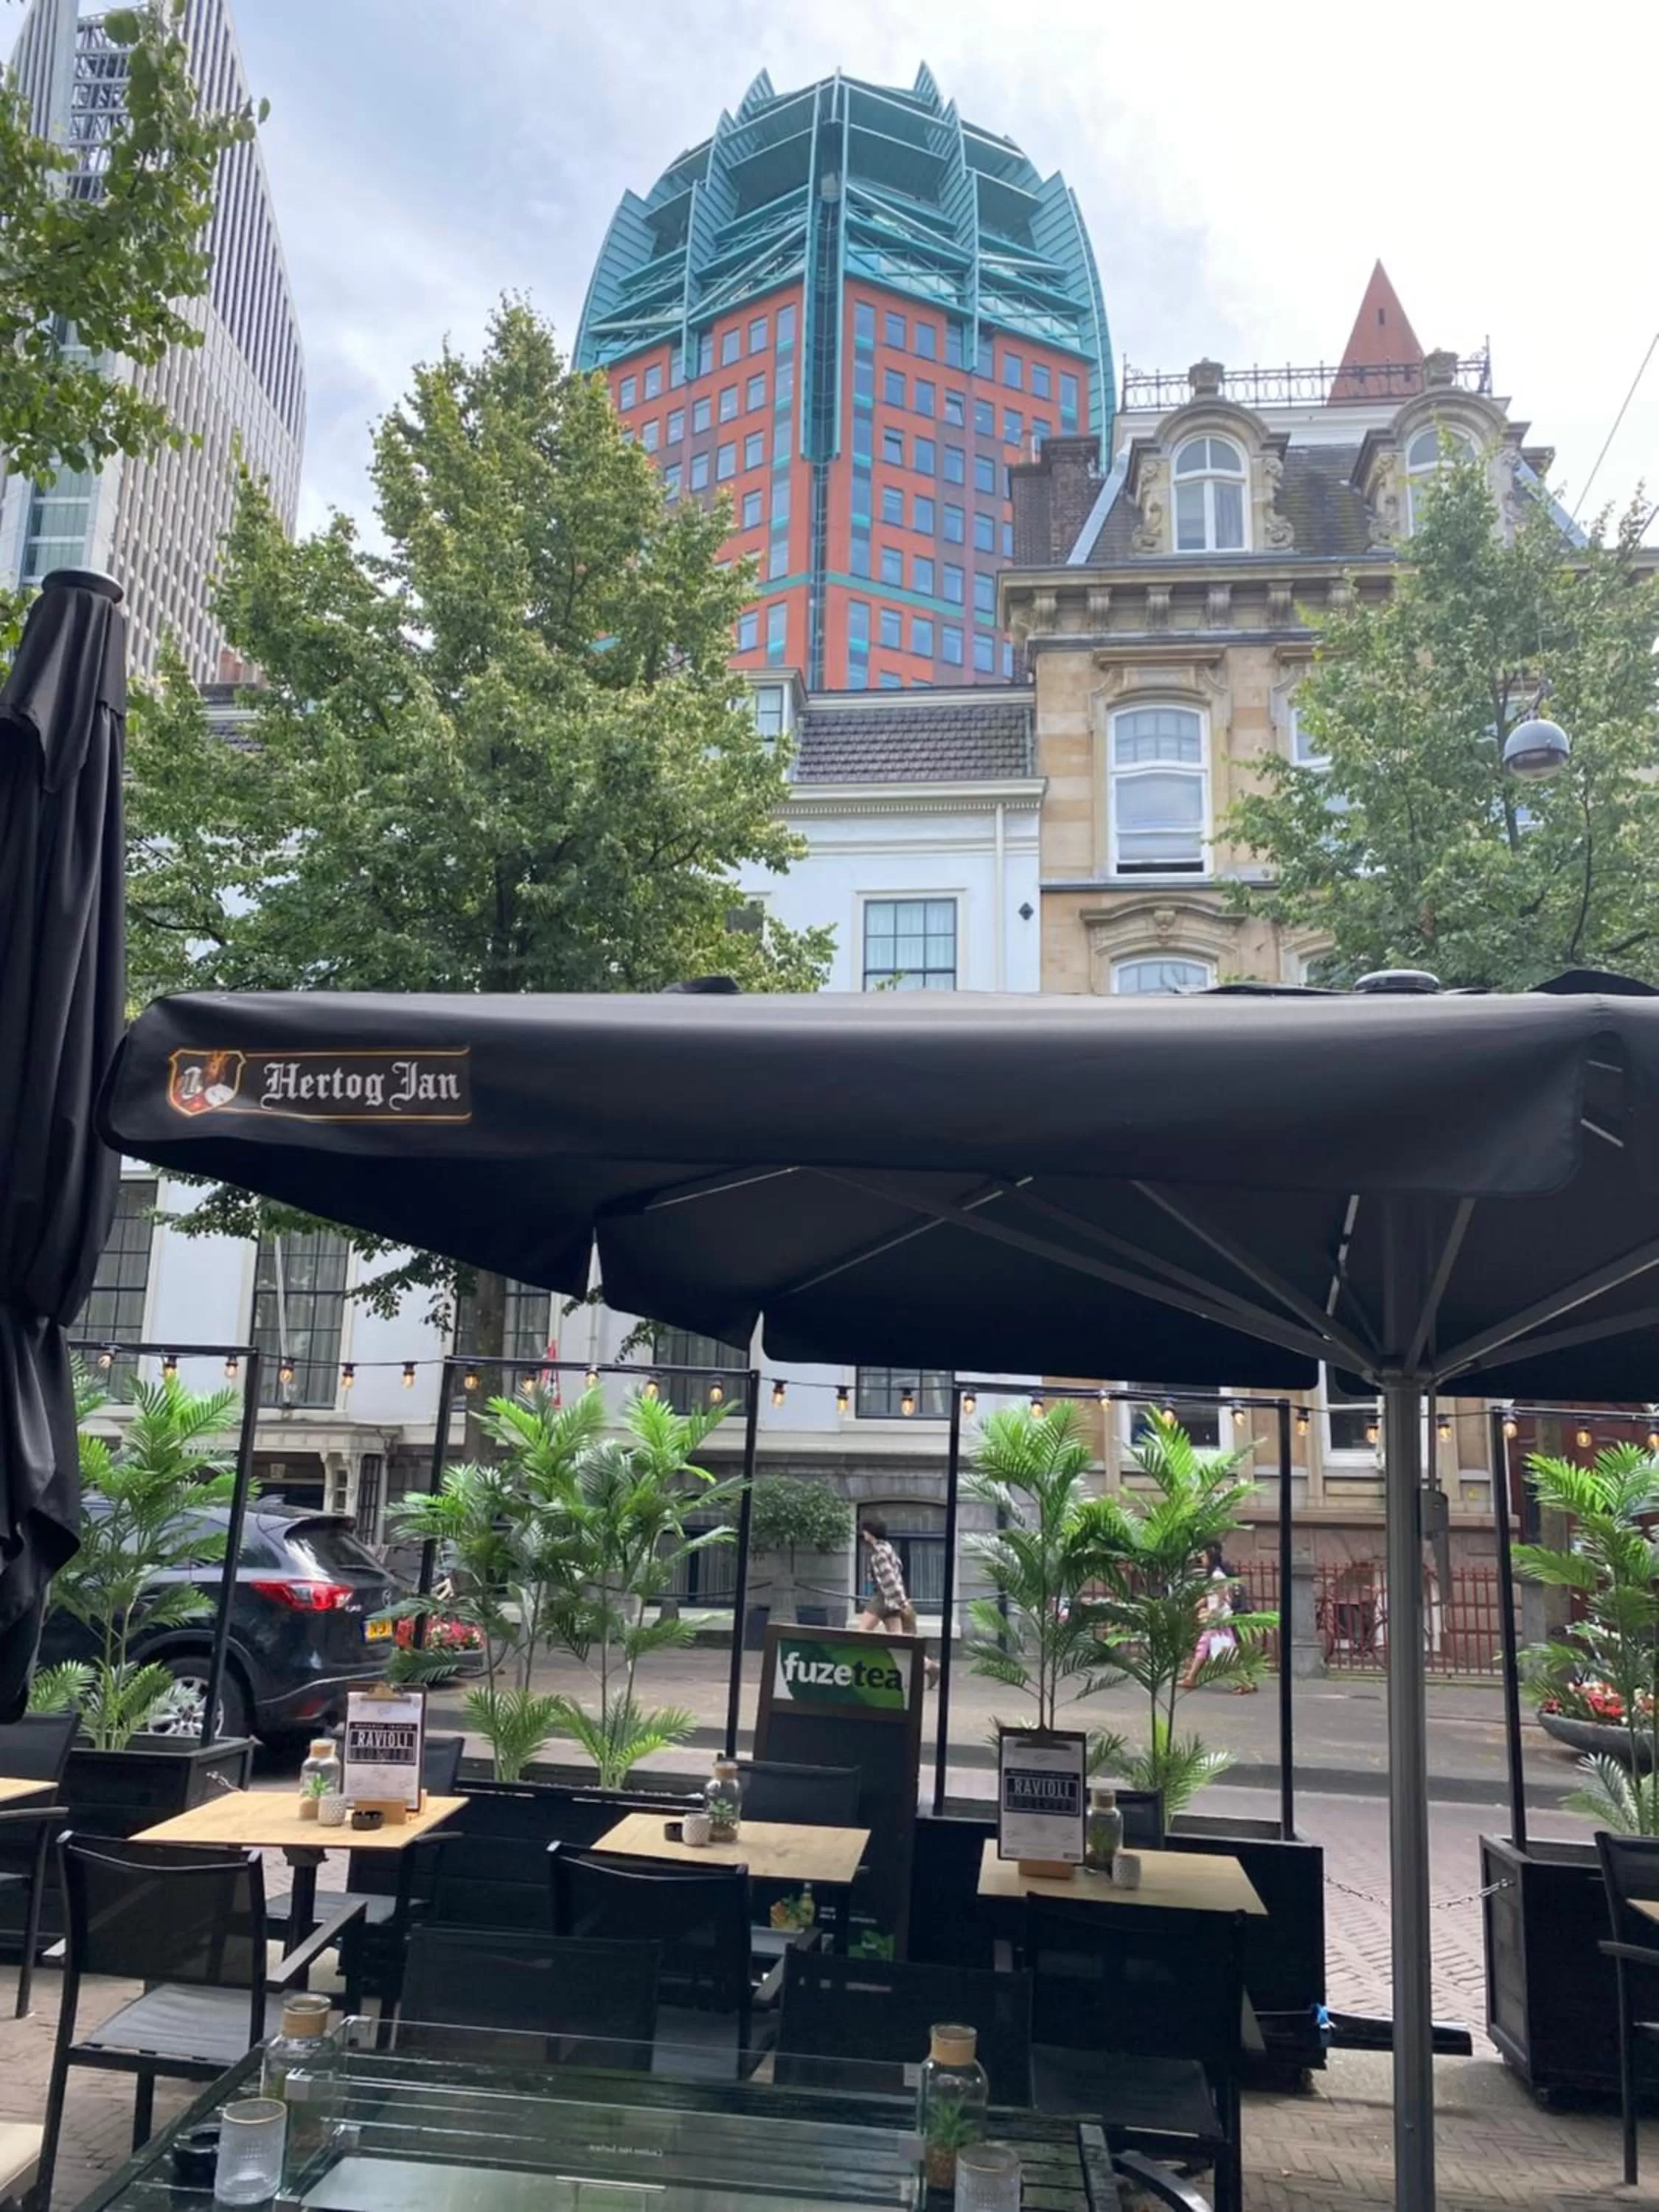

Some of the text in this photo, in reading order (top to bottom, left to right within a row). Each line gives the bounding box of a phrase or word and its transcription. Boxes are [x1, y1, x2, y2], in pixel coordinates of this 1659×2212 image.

[260, 1062, 461, 1110] Hertog Jan
[358, 1730, 408, 1747] RAVIOLI
